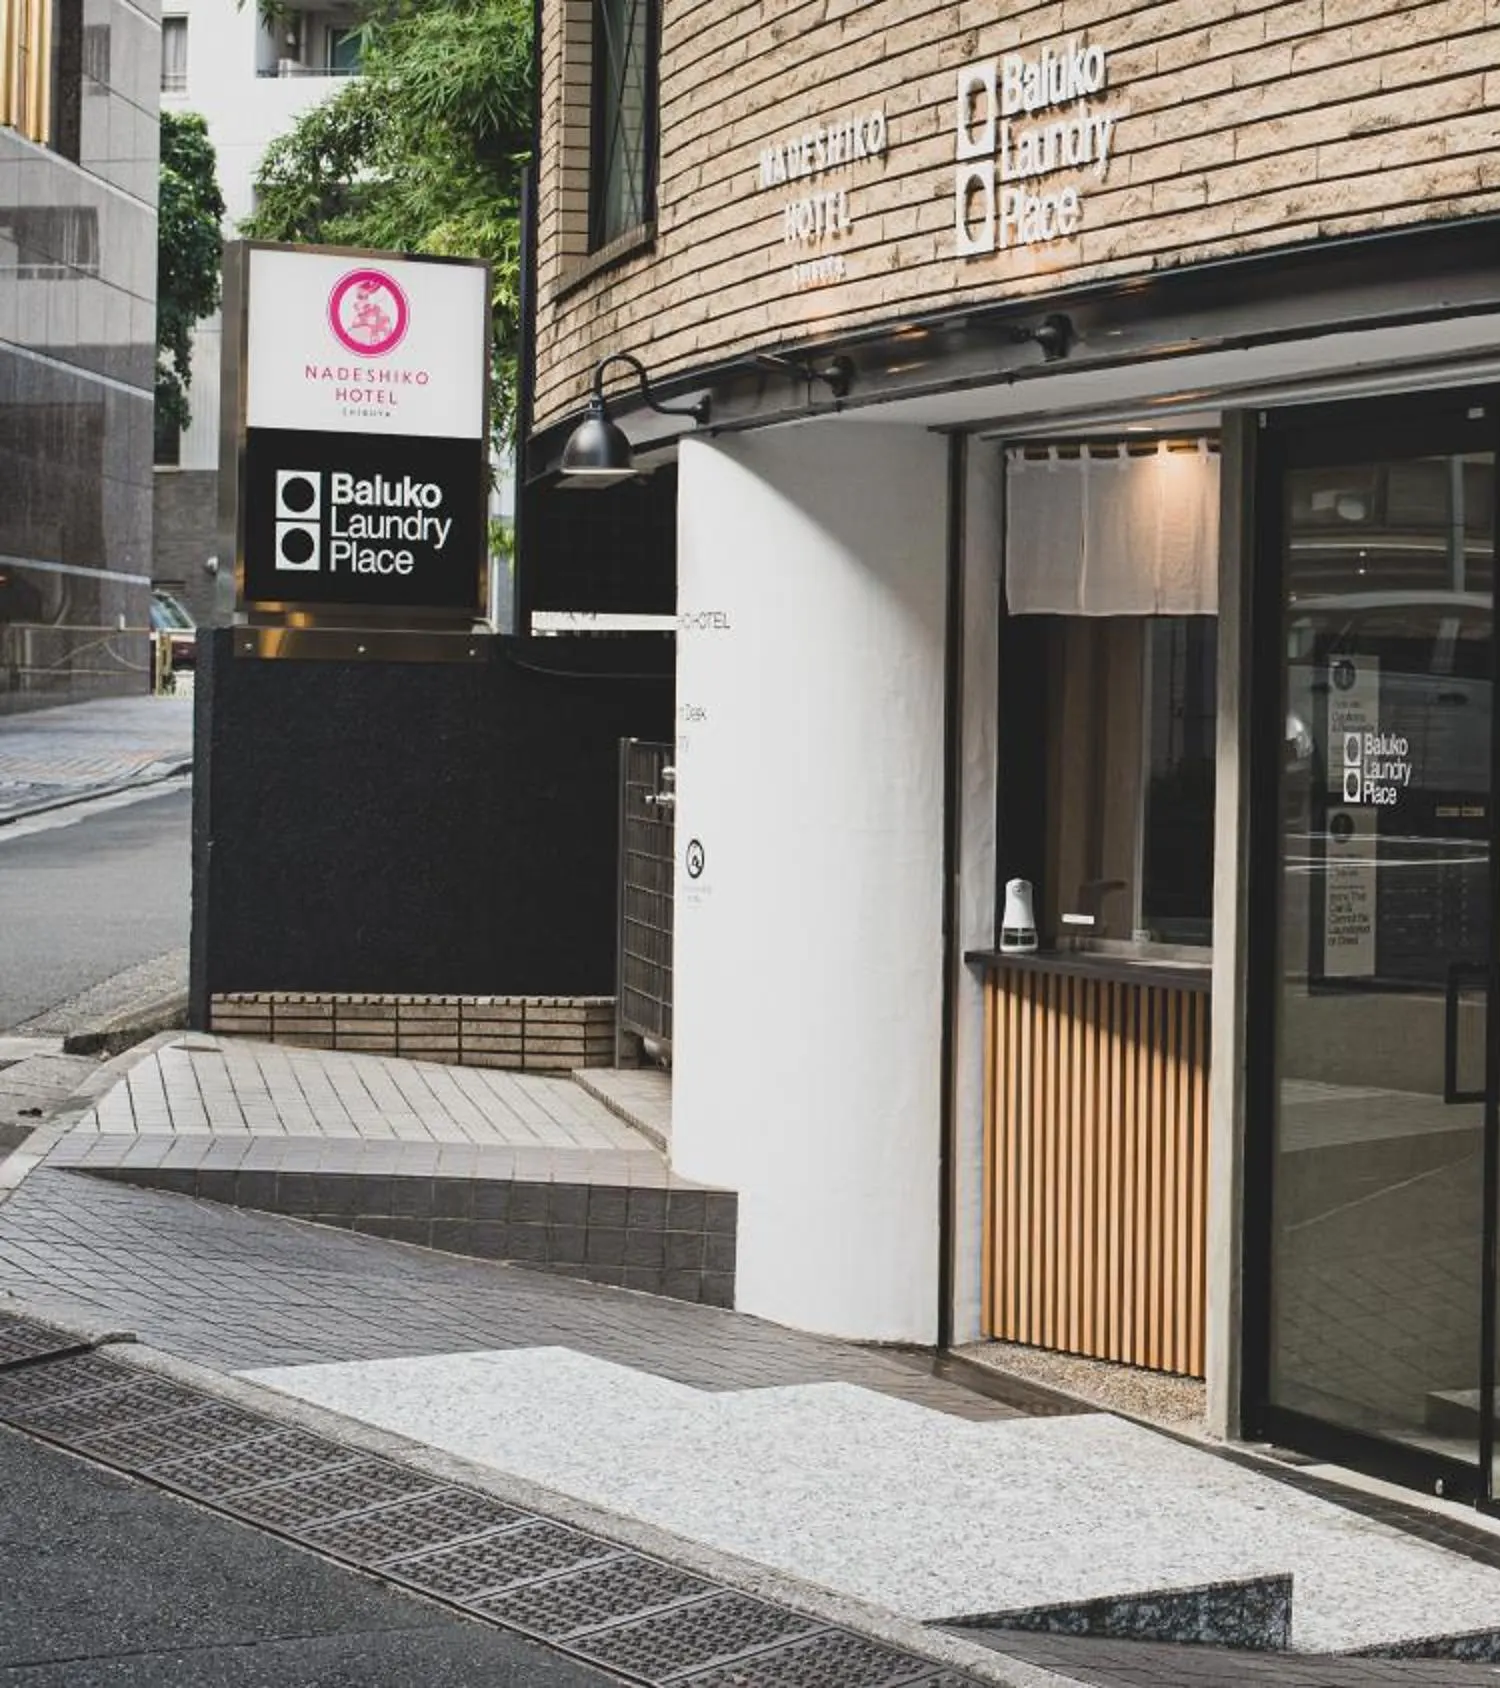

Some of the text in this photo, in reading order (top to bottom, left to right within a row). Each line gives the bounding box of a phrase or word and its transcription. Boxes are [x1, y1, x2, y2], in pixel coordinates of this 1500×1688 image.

[1002, 40, 1106, 115] Baluko
[1001, 97, 1115, 180] Laundry
[784, 187, 851, 245] HOTEL
[999, 185, 1081, 250] Place
[304, 364, 430, 385] NADESHIKO
[335, 387, 398, 405] HOTEL
[330, 471, 443, 509] Baluko
[329, 505, 453, 550] Laundry
[328, 540, 415, 575] Place
[1363, 732, 1409, 757] Baluko
[1363, 754, 1413, 787] Laundry
[1363, 780, 1398, 805] Place
